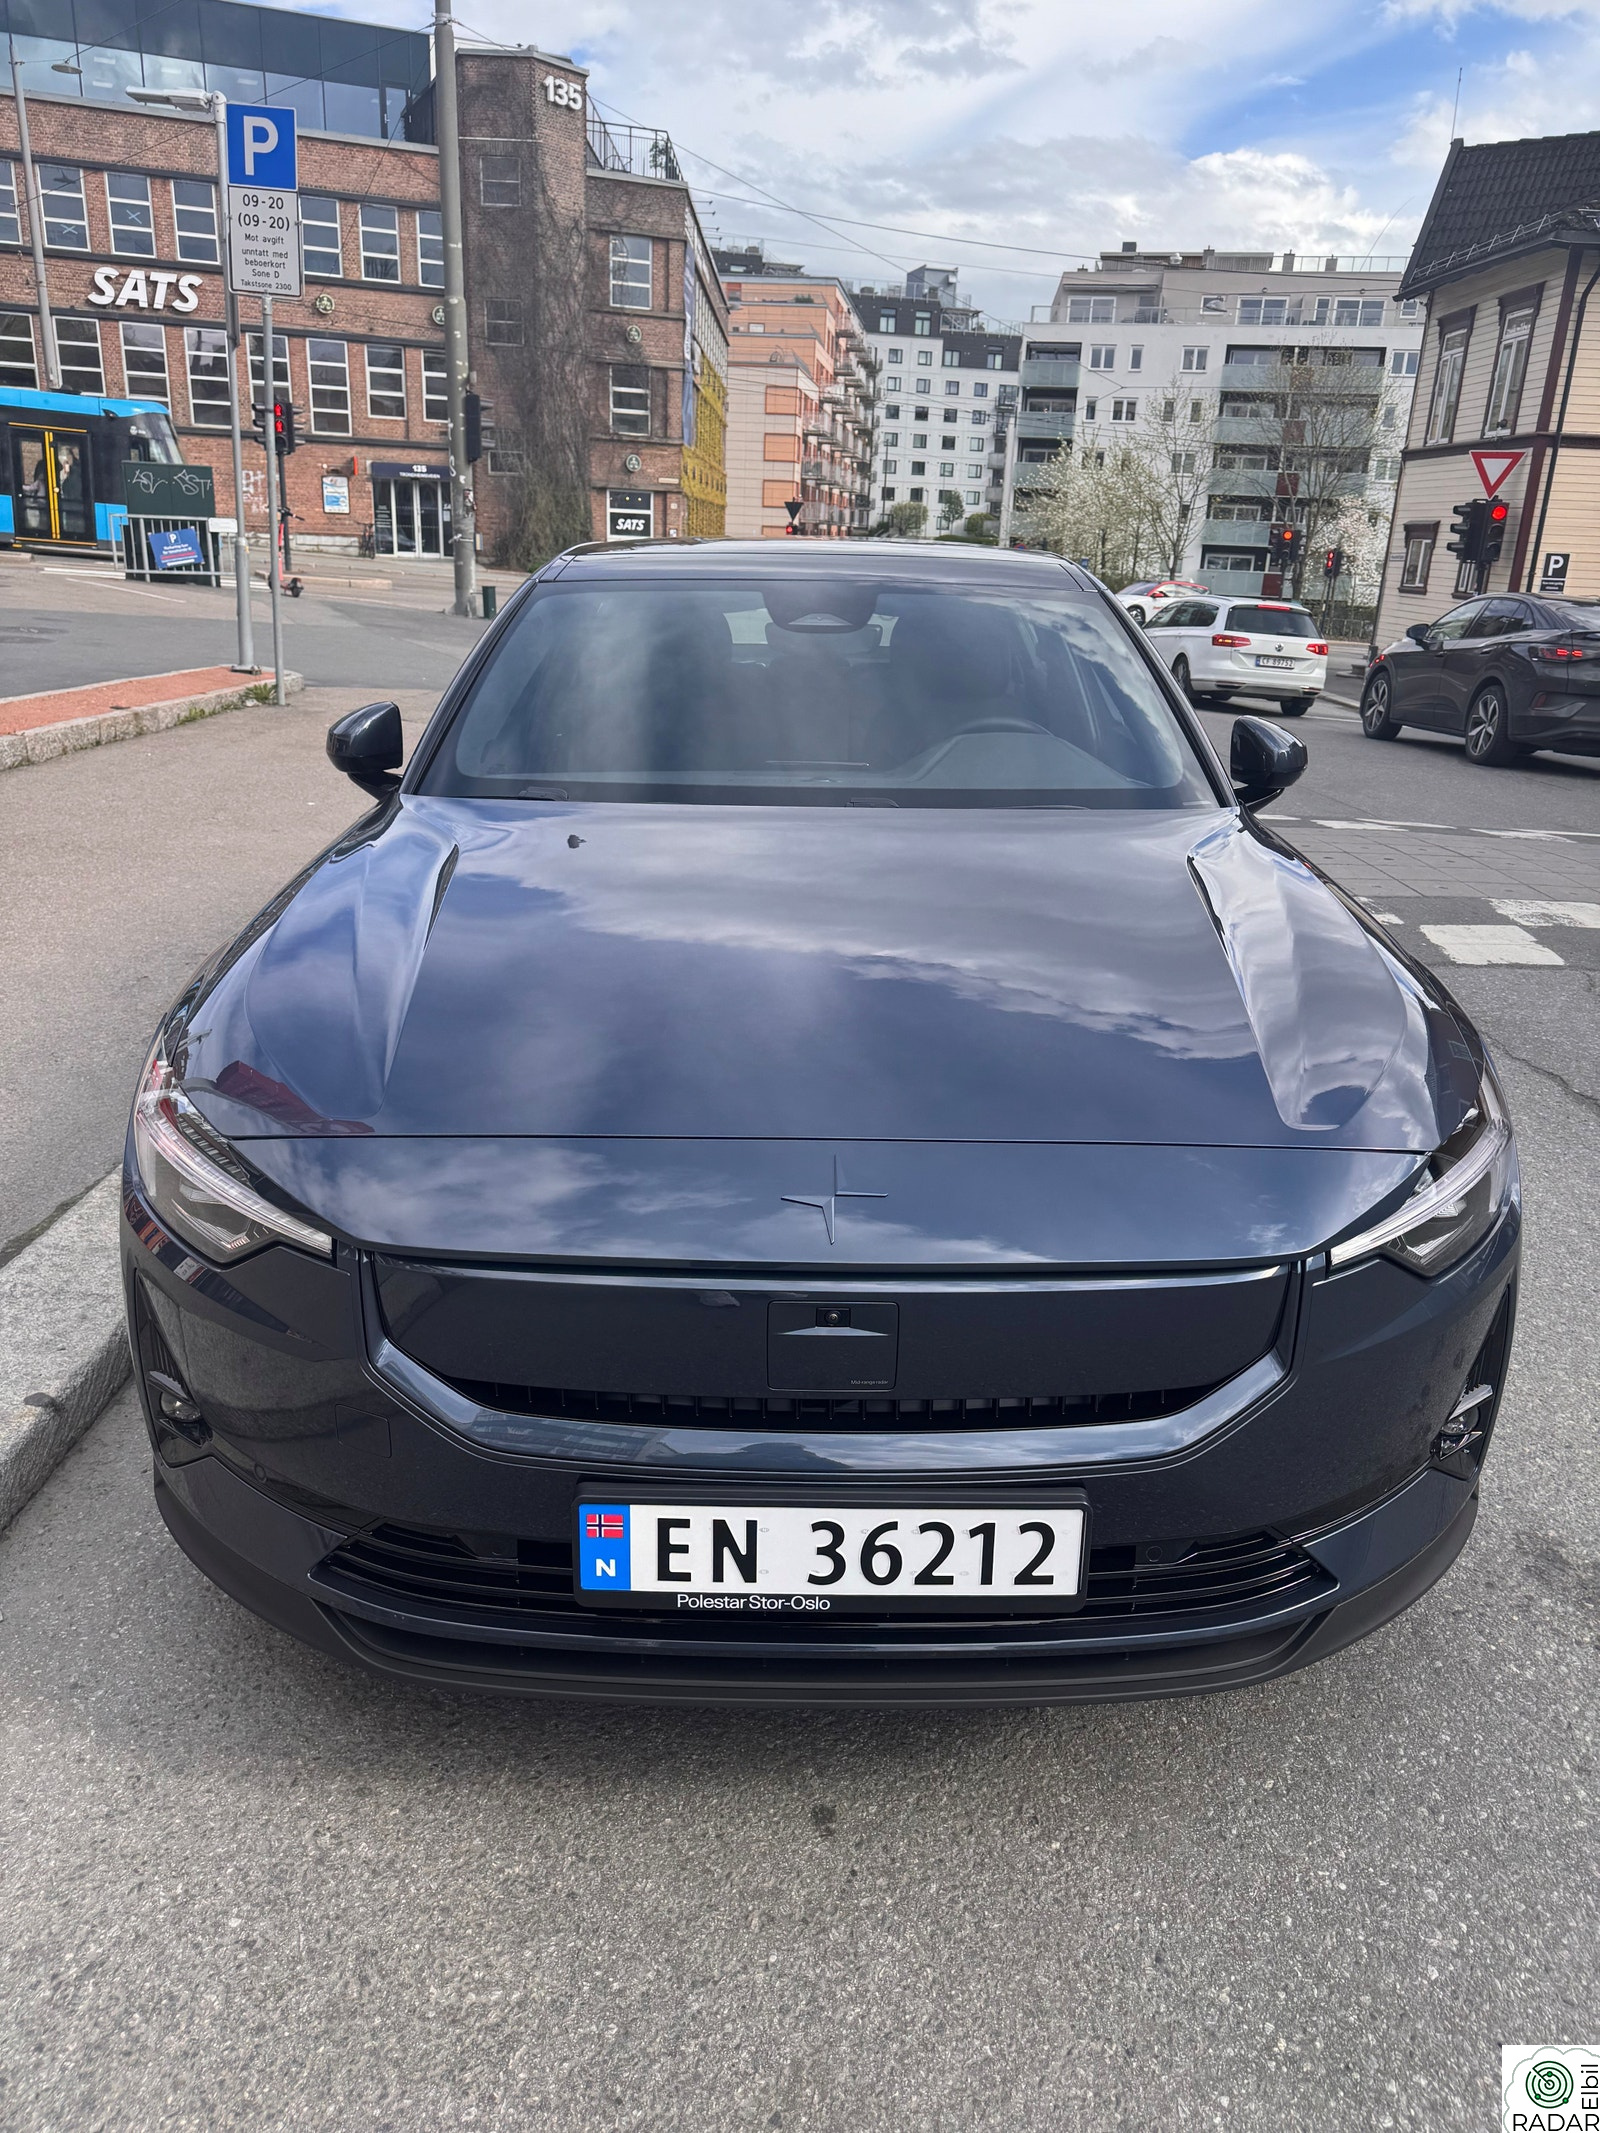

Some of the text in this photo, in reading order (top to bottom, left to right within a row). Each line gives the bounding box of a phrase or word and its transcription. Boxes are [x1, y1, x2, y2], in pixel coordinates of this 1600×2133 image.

[543, 75, 582, 110] 135
[243, 116, 279, 176] P
[244, 233, 284, 245] Mot avgift
[241, 248, 288, 259] unntatt med
[244, 258, 286, 269] beboerkort
[252, 269, 280, 279] Sone D
[87, 266, 204, 313] SATS
[240, 279, 292, 291] Takstsone 2300
[412, 465, 427, 473] 135
[616, 518, 646, 531] SATS
[169, 533, 177, 544] P
[1547, 555, 1564, 576] P
[595, 1517, 1055, 1586] N EN 36212
[677, 1594, 831, 1611] Polestar Stor-Oslo
